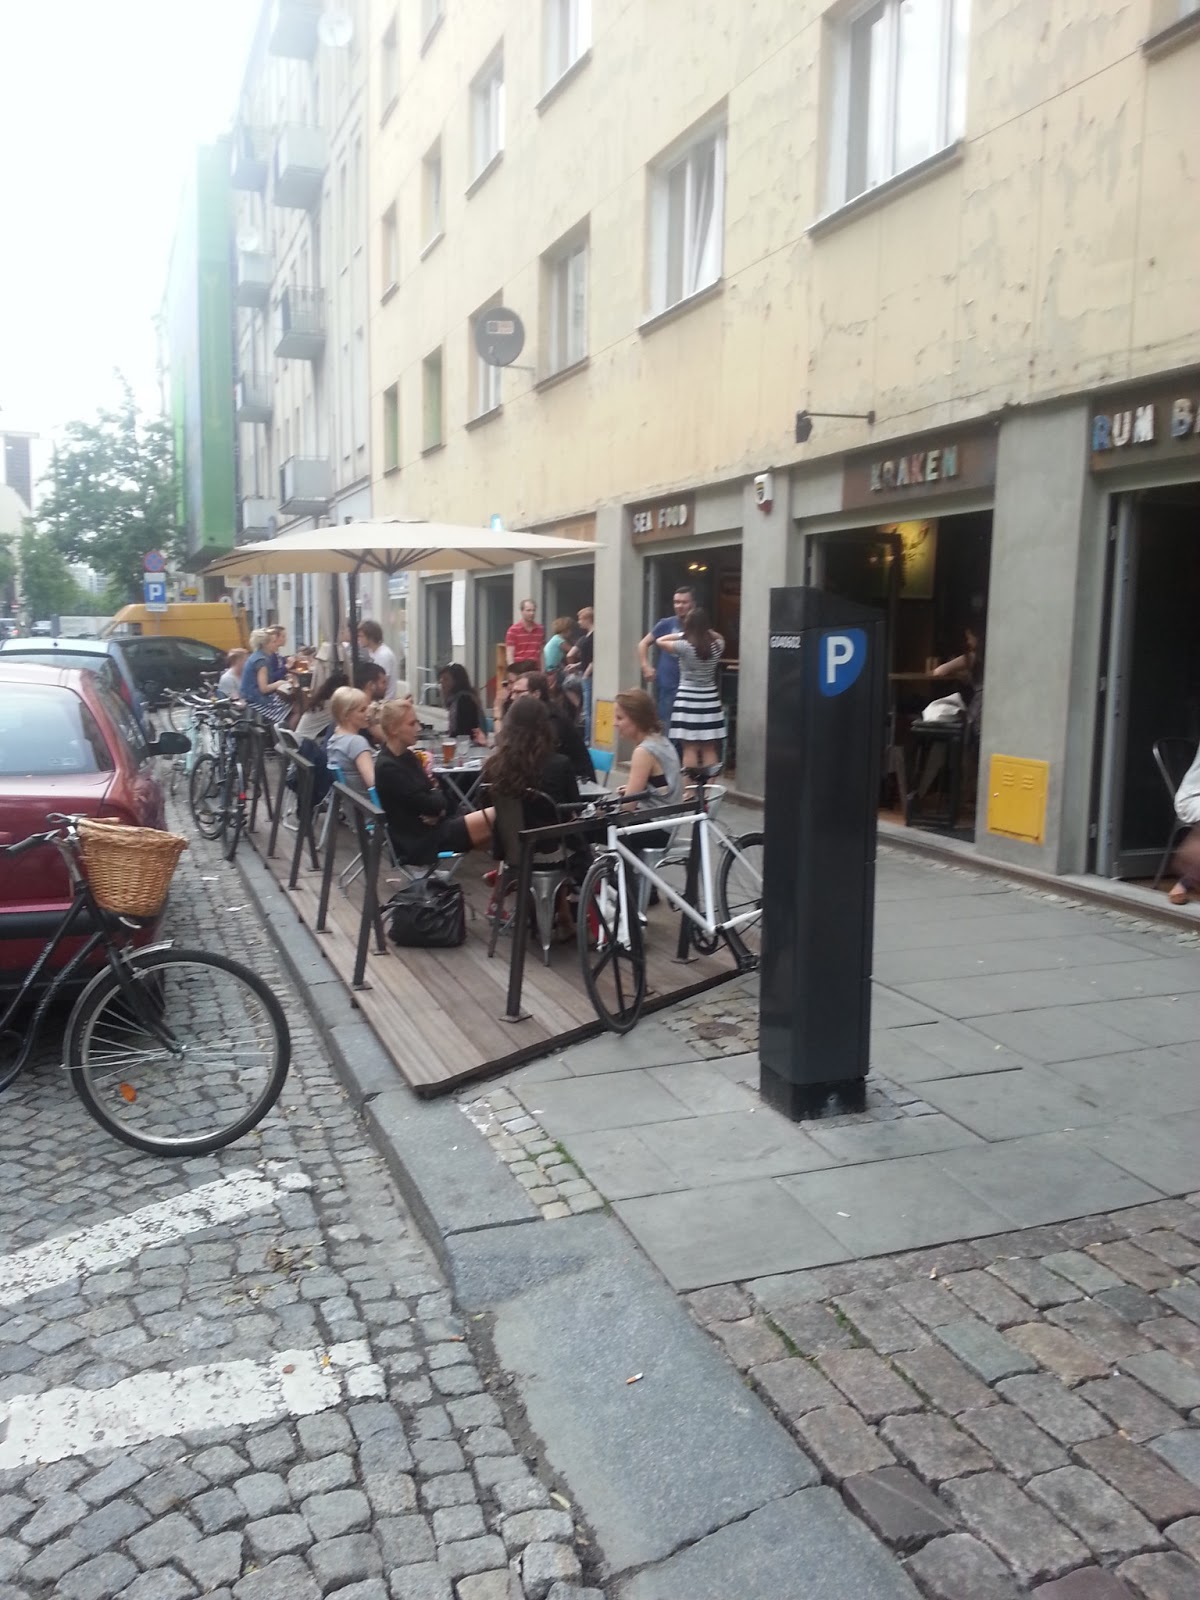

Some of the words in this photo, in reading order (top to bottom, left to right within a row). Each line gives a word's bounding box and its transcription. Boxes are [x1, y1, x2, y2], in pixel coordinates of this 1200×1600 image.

[1092, 404, 1154, 451] RUM
[1171, 398, 1200, 437] B
[870, 445, 958, 491] KRAKEN
[633, 511, 653, 533] SEA
[658, 504, 688, 529] FOOD
[149, 584, 163, 601] P
[826, 635, 855, 684] P
